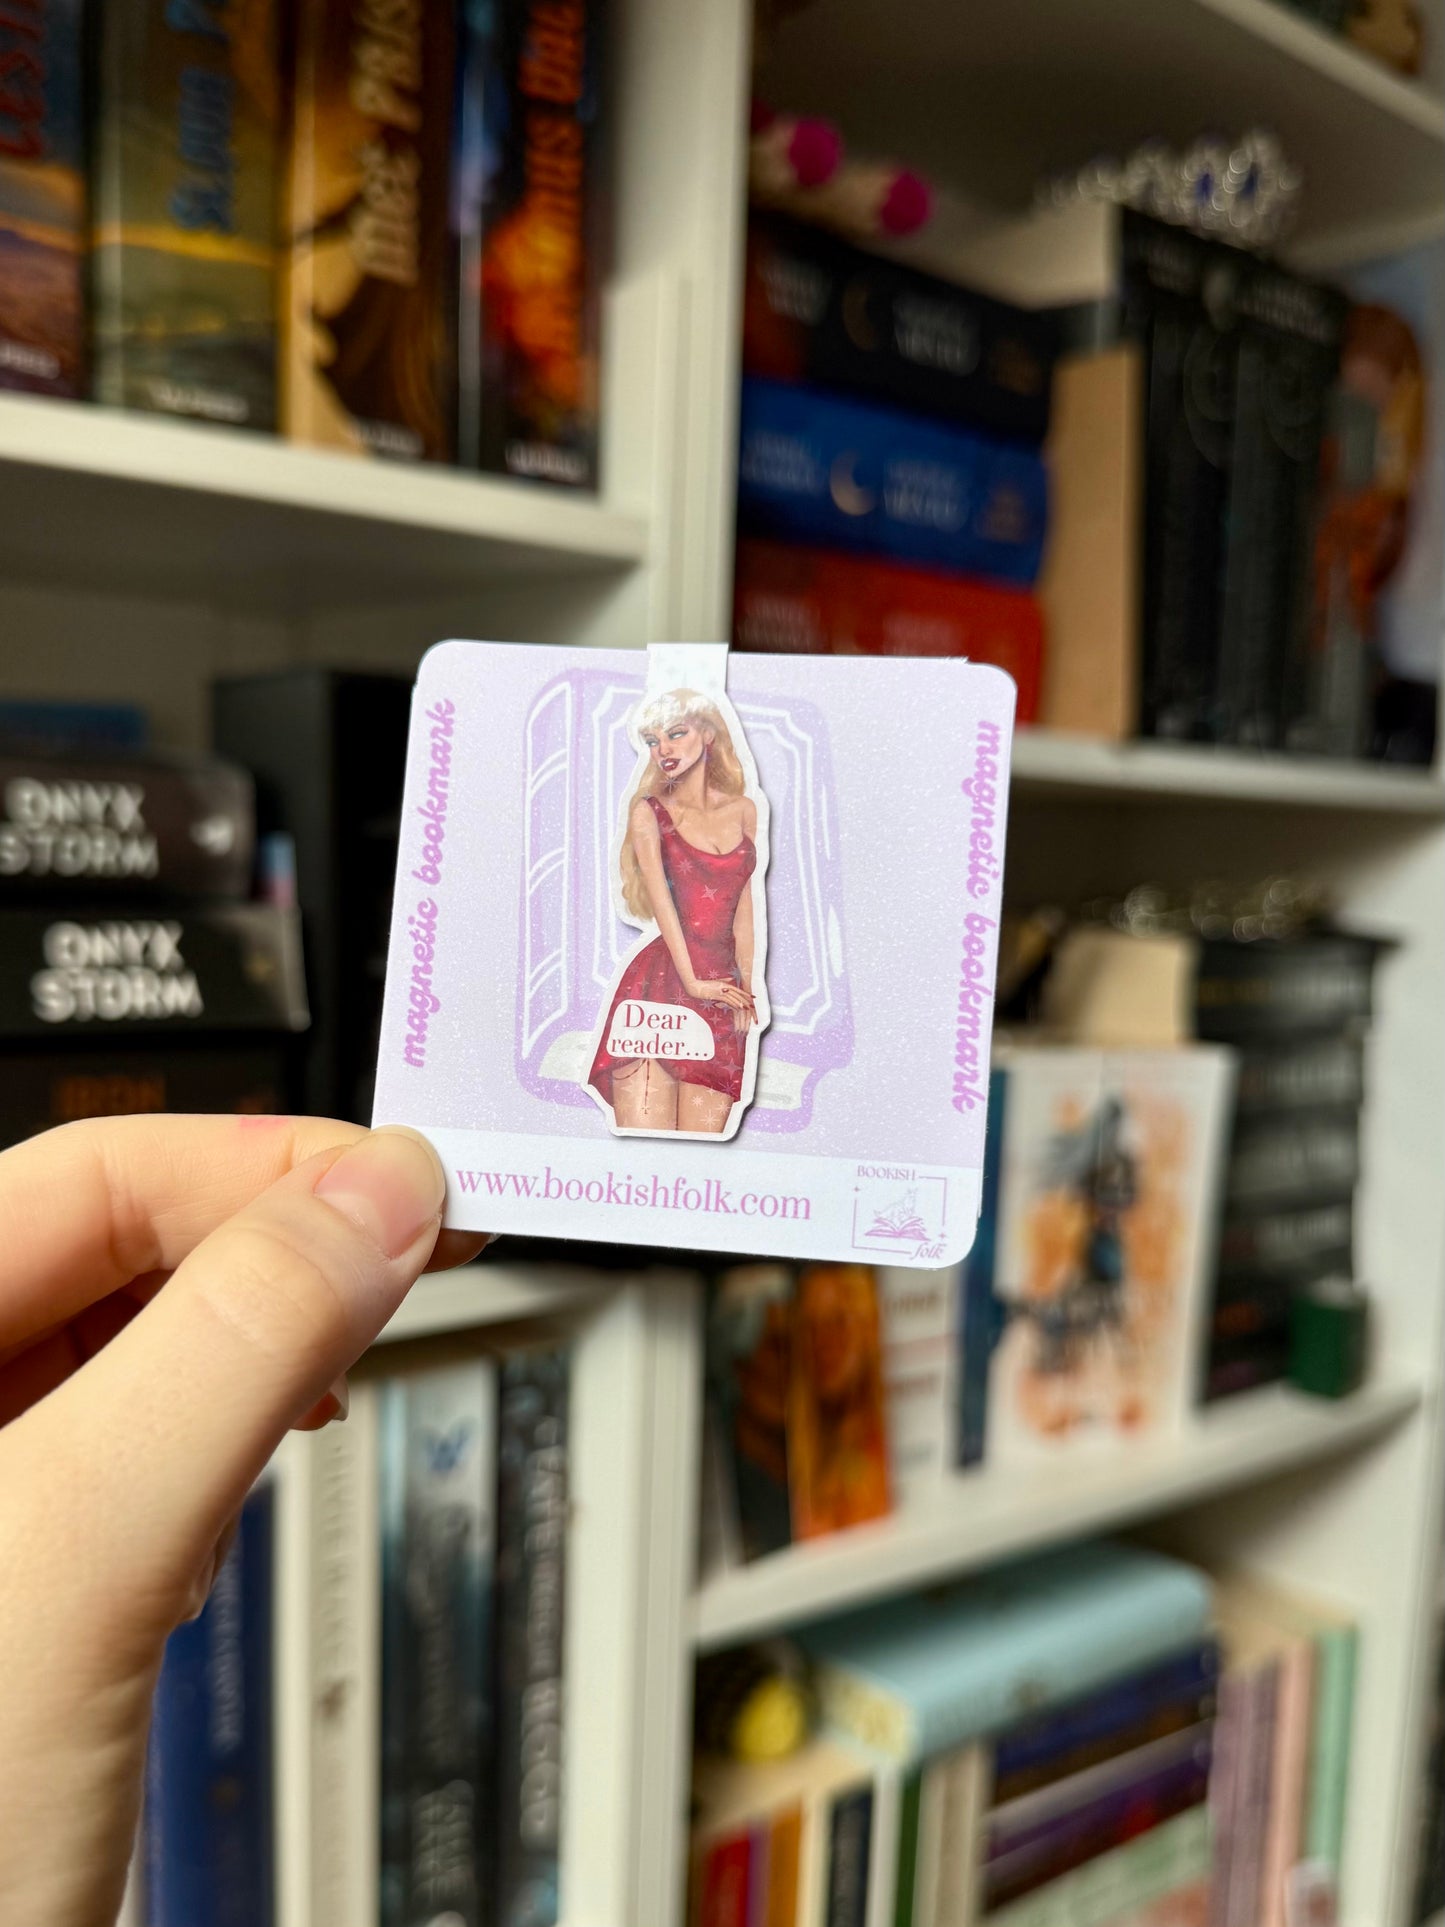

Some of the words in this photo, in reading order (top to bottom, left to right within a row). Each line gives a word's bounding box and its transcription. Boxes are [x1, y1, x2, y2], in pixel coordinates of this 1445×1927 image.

[5, 777, 145, 829] ONYX
[411, 698, 456, 885] bookmark
[961, 720, 1000, 899] magnetic
[0, 823, 158, 878] STORM
[43, 921, 183, 970] ONYX
[31, 966, 203, 1022] STORM
[404, 897, 441, 1067] magnetic
[624, 1003, 687, 1030] Dear
[952, 912, 997, 1114] bookmark
[611, 1032, 708, 1057] reader...
[455, 1166, 812, 1221] www.bookishfolk.com
[857, 1165, 916, 1181] BOOKISH
[909, 1241, 948, 1261] folk
